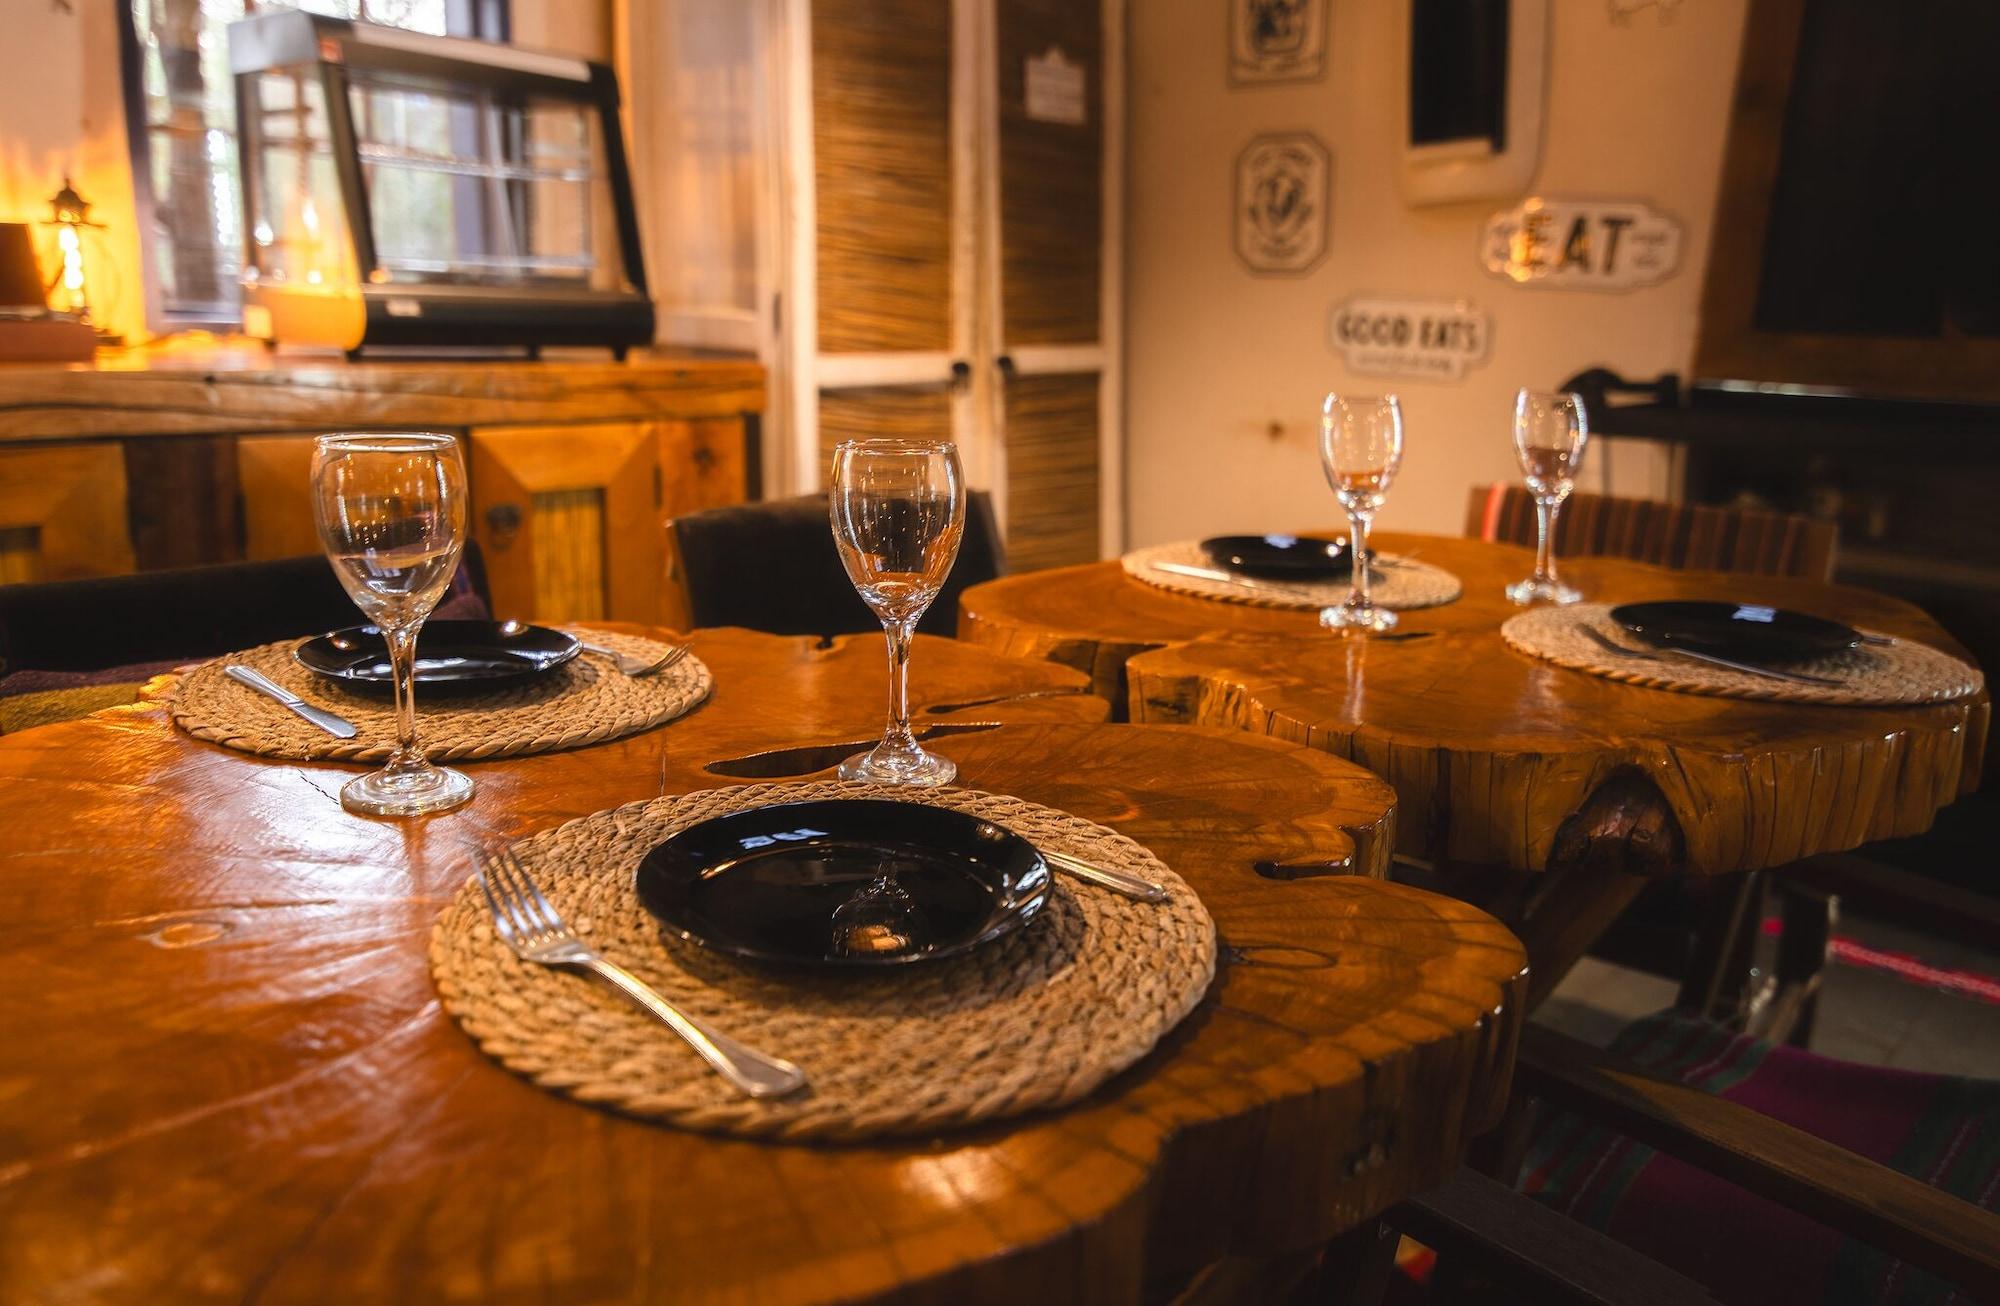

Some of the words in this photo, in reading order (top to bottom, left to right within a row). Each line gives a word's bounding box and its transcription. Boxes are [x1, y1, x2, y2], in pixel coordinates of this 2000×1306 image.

[1522, 212, 1635, 275] EAT
[1336, 309, 1411, 348] GOOD
[1418, 314, 1477, 351] EATS
